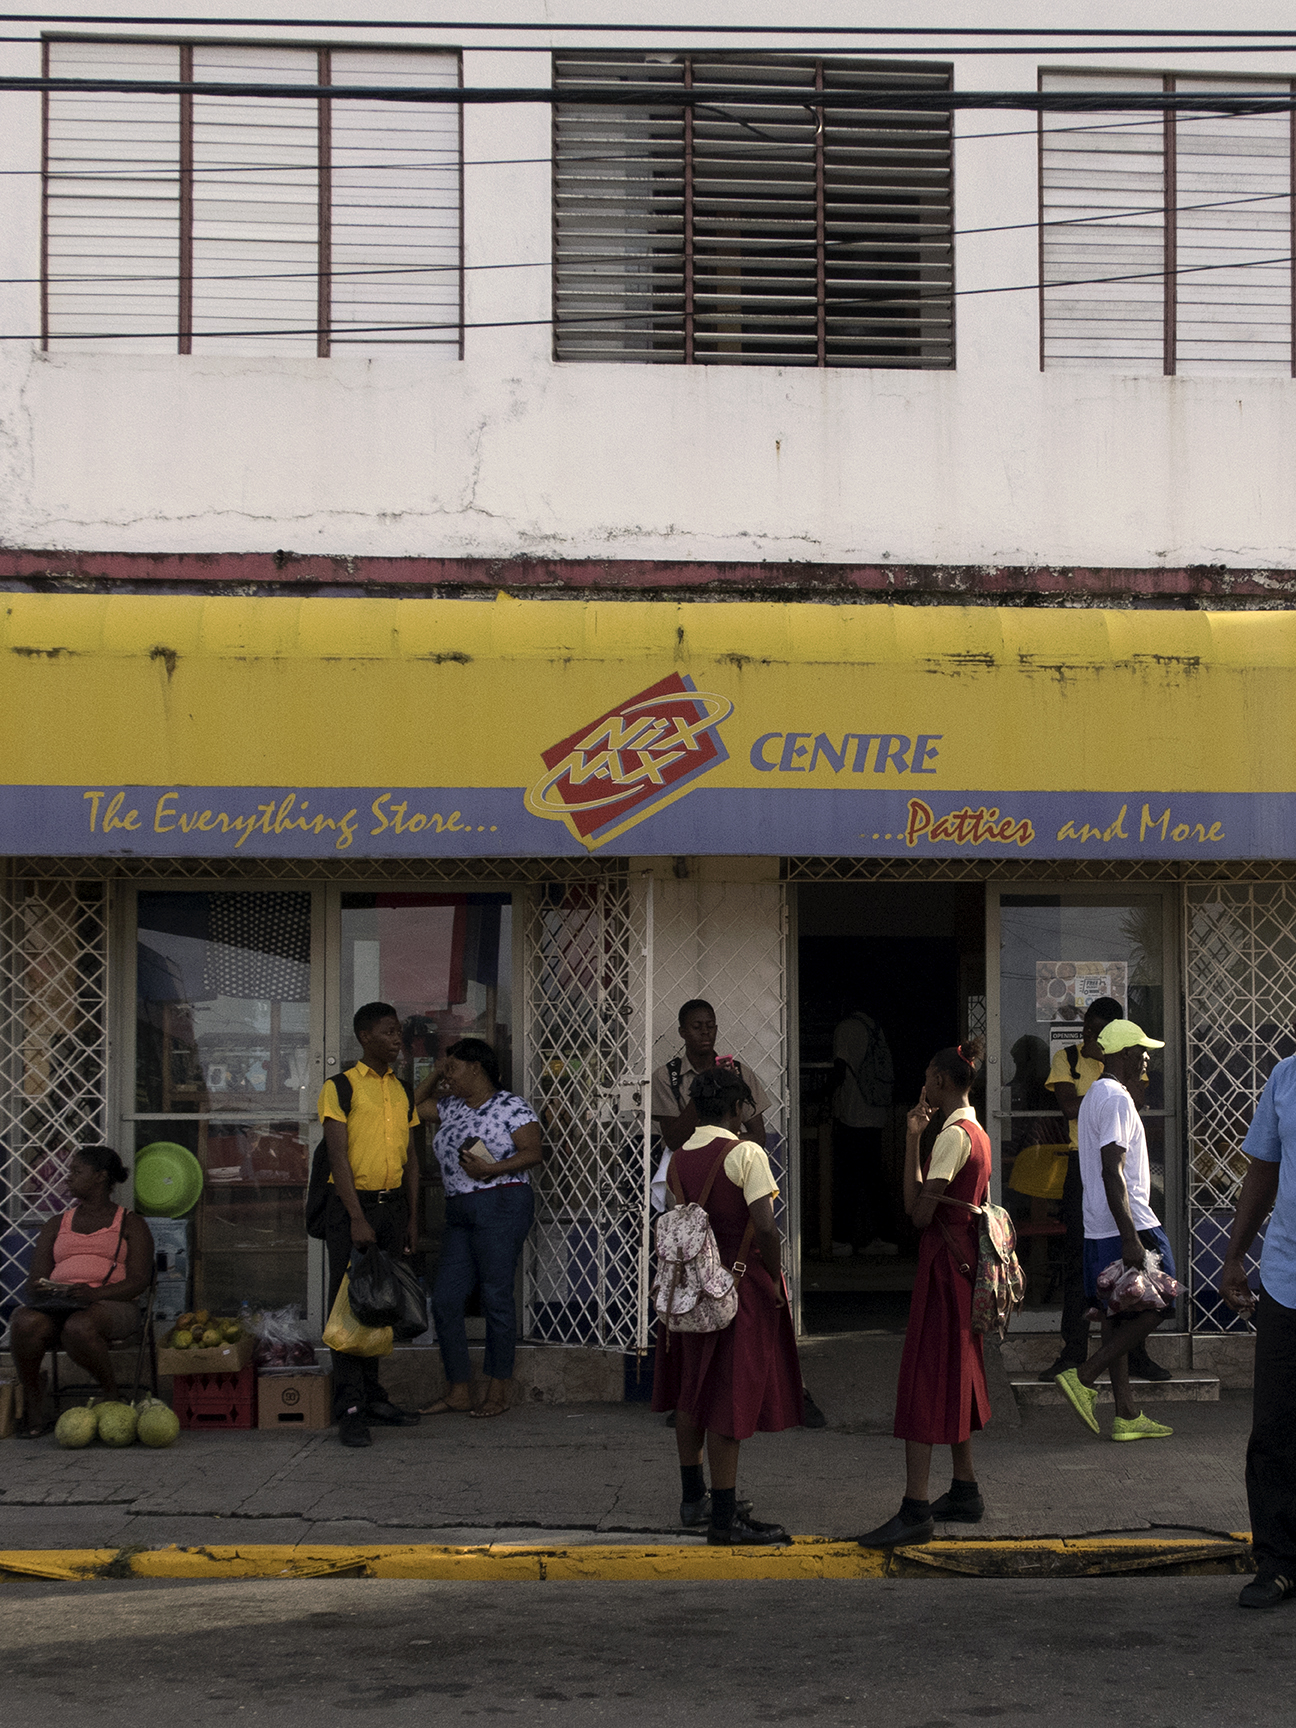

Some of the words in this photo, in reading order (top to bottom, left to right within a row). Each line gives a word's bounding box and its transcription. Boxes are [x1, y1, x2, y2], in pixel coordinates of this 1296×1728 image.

[750, 732, 942, 774] CENTRE
[83, 790, 142, 833] The
[153, 791, 358, 850] Everything
[370, 792, 497, 837] Store...
[1056, 804, 1129, 843] and
[1139, 803, 1225, 843] More
